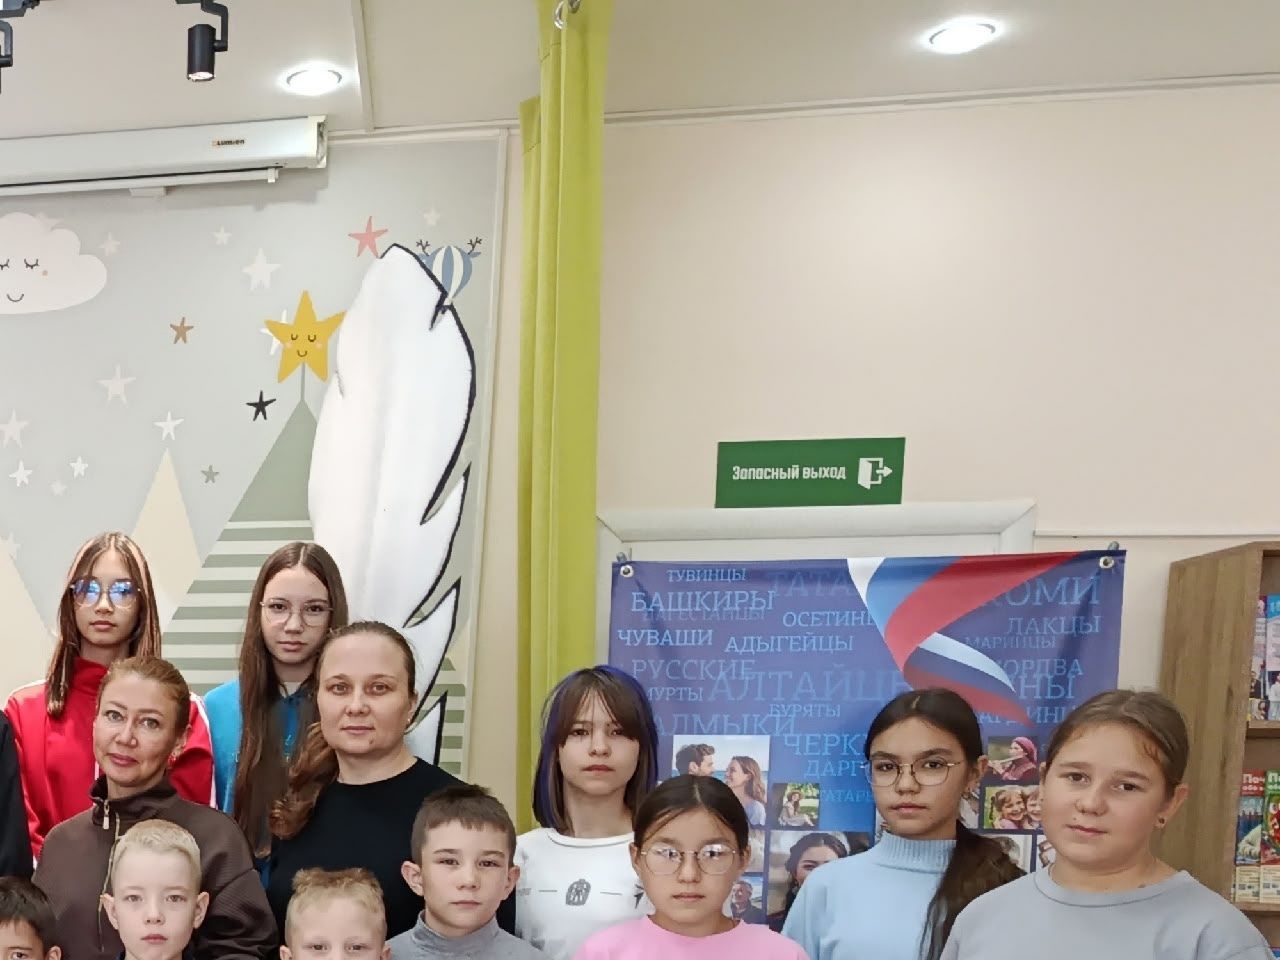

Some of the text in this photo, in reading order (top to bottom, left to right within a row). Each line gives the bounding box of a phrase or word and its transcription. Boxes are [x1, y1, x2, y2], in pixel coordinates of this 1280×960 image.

[732, 464, 847, 480] Запасный выход
[667, 567, 746, 583] ТУВИНЦЫ
[630, 590, 775, 613] БАШКИРЫ
[993, 576, 1102, 606] ОМИ
[1007, 616, 1101, 637] ЛАКЦЫ
[617, 629, 714, 647] ЧУВАШИ
[724, 631, 855, 655] АДЫГЕЙЦЫ
[631, 658, 757, 681] РУССКИЕ
[997, 658, 1083, 679] ОРДВА
[648, 686, 704, 702] УРТЫ
[770, 703, 841, 718] БУРЯТЫ
